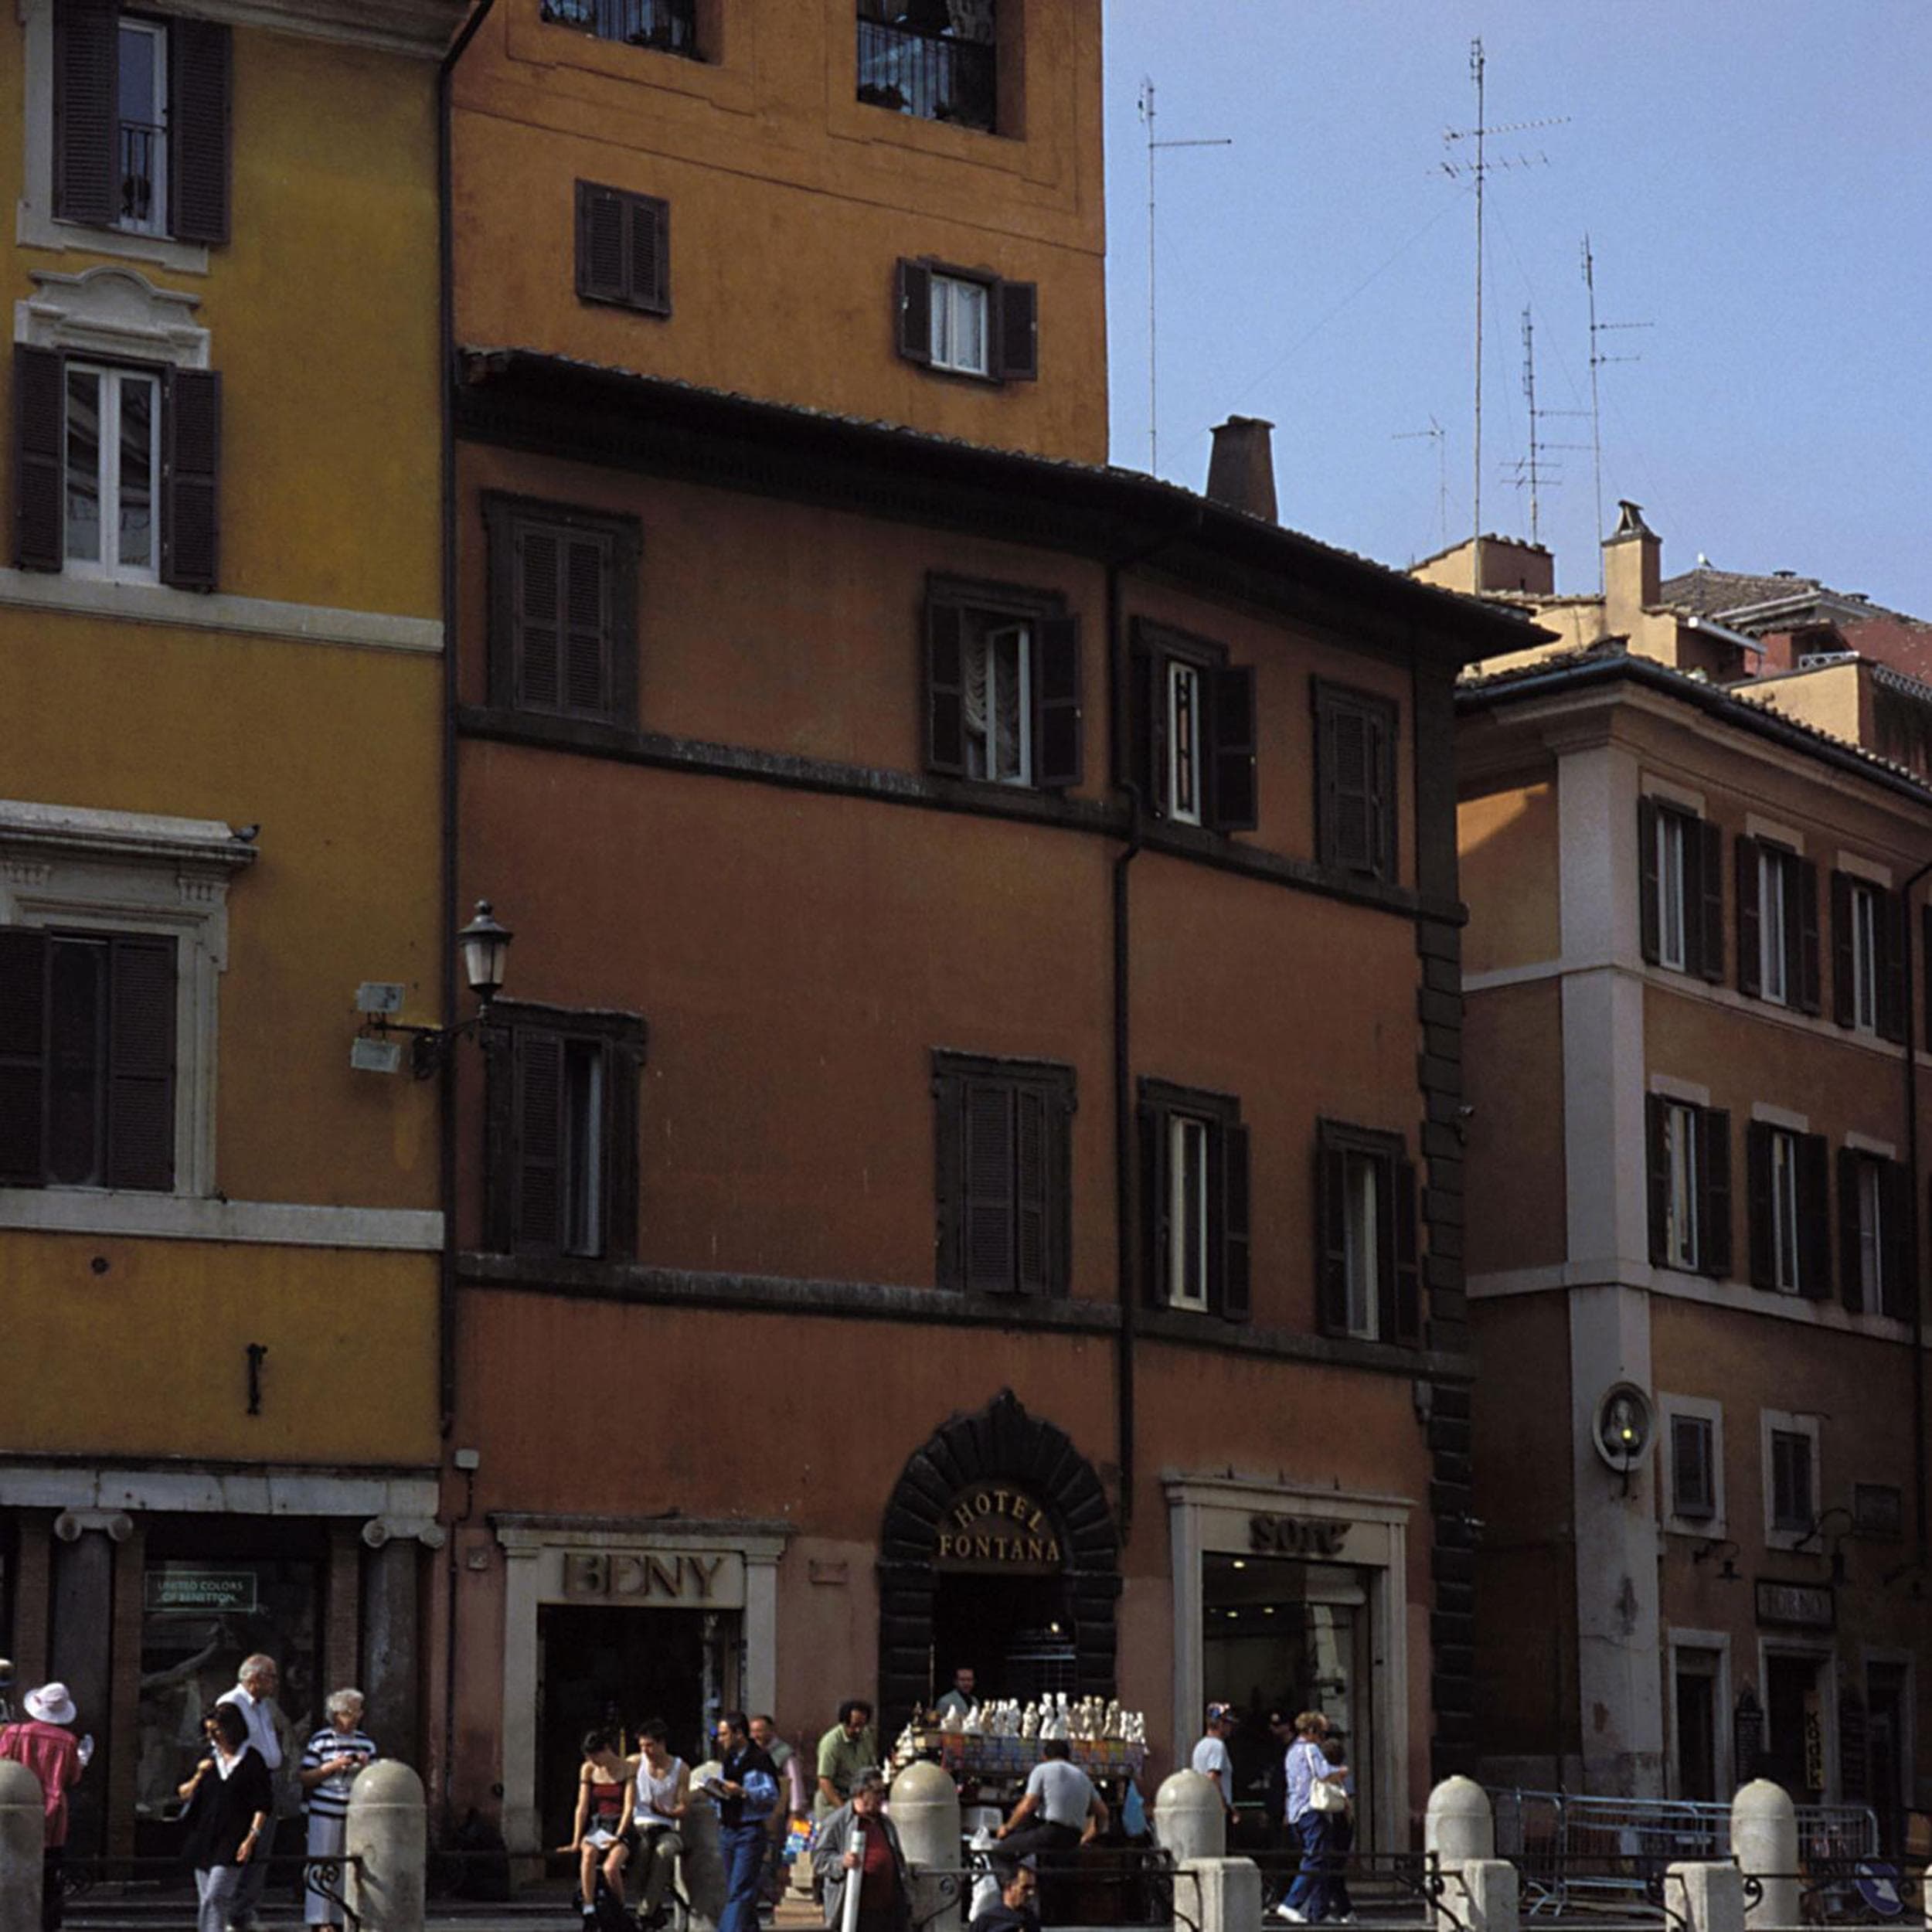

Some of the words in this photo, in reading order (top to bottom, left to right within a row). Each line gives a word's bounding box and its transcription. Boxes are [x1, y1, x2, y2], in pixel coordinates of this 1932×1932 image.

[954, 1490, 1043, 1534] HOTEL
[938, 1534, 1060, 1562] FONTANA
[157, 1580, 198, 1591] UNITED
[199, 1580, 243, 1592] COLORS
[563, 1552, 723, 1598] BENY
[1806, 1710, 1821, 1787] Kodak
